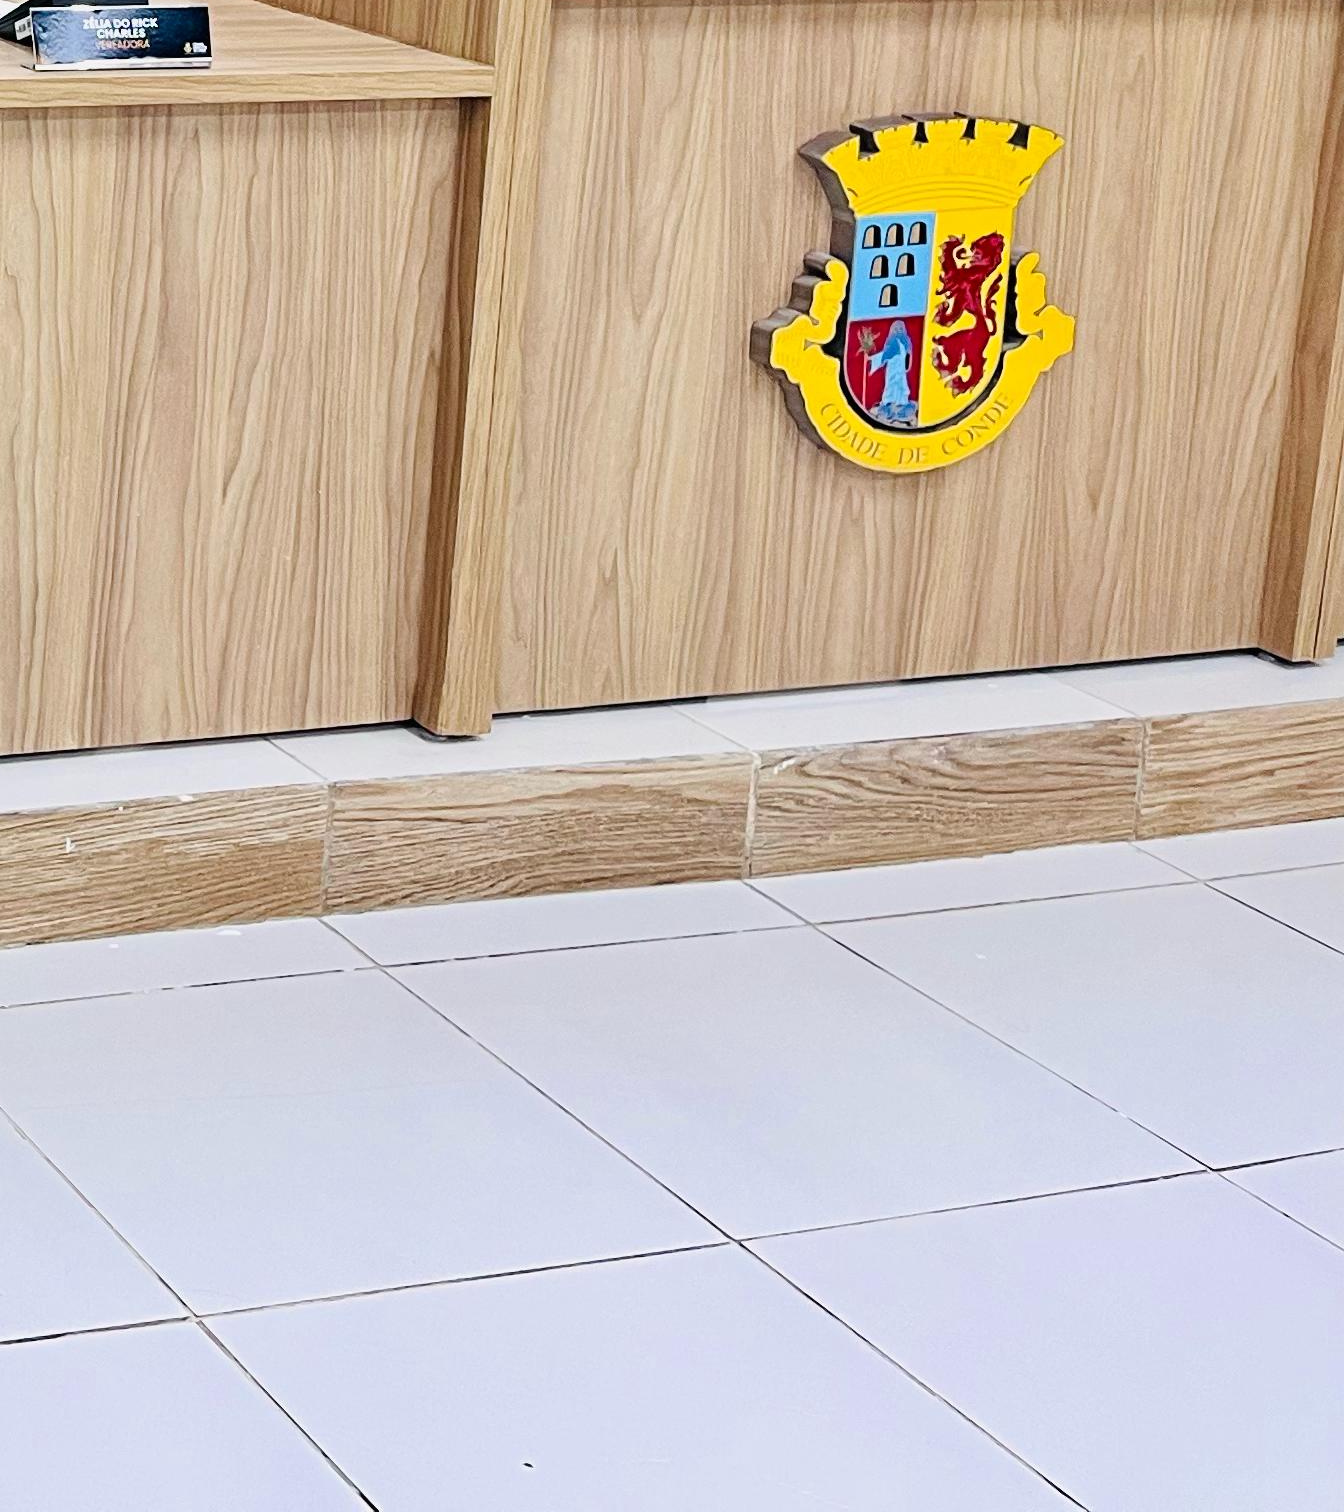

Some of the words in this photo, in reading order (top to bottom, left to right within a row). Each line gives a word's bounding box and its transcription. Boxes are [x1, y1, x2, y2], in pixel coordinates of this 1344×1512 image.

[113, 18, 131, 29] DO
[96, 28, 147, 39] CHARLES
[820, 402, 888, 462] CIDADE
[898, 445, 930, 465] DE
[940, 392, 1010, 457] CONDE
